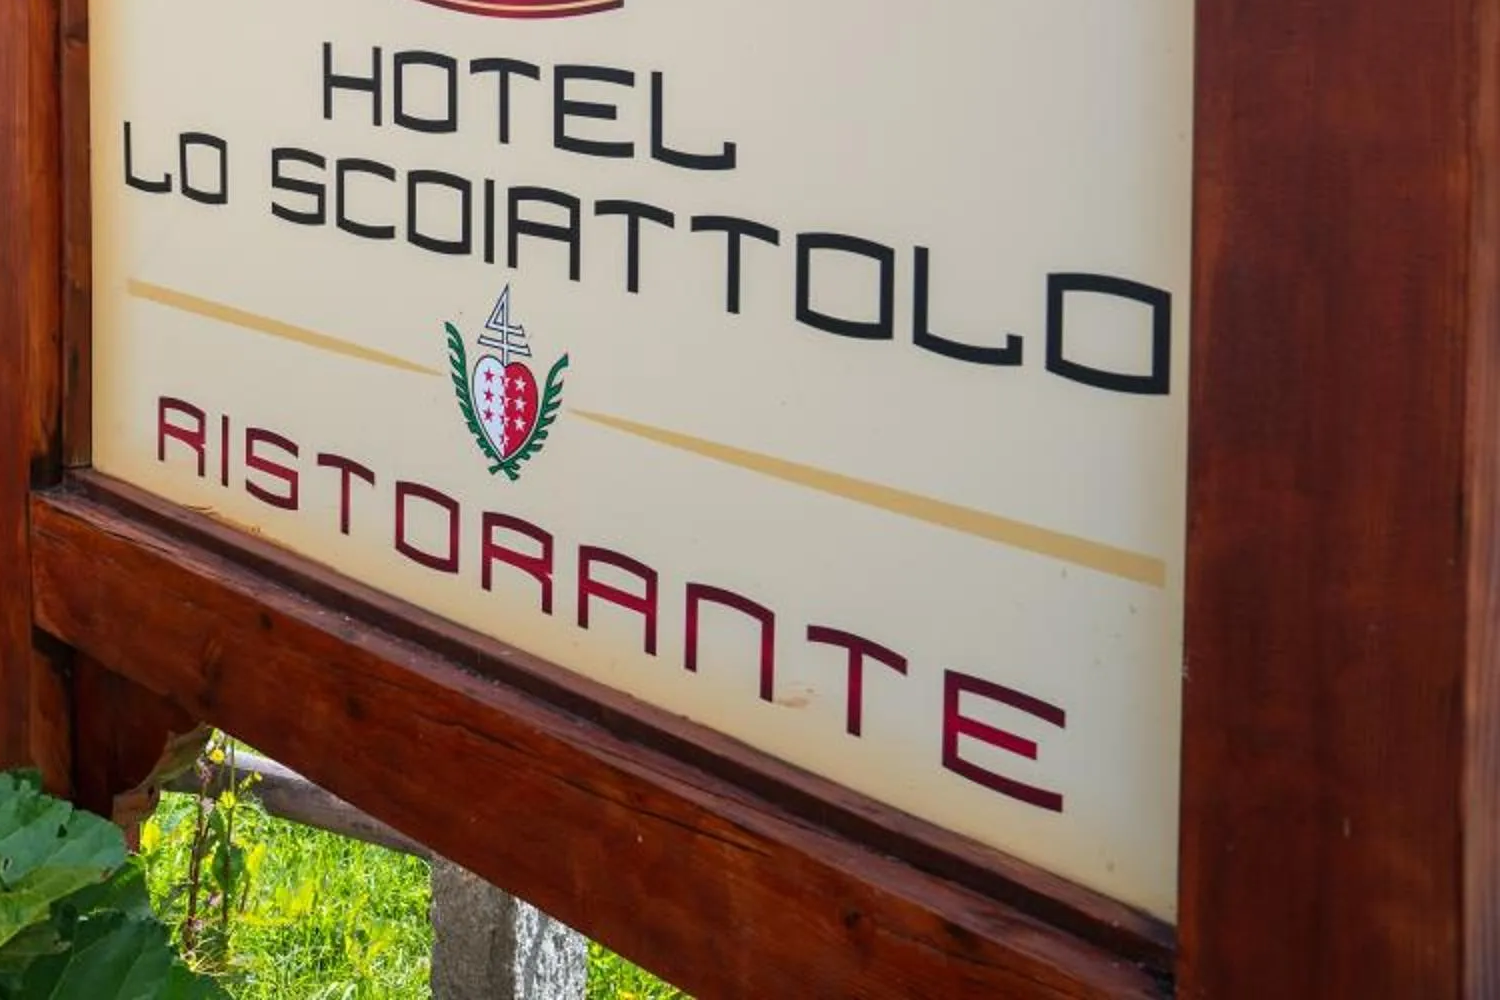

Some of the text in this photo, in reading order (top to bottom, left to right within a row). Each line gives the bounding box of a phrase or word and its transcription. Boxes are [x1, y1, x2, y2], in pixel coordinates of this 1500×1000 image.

[322, 42, 737, 171] HOTEL
[122, 121, 1173, 396] LO SCOIATTOLO
[157, 396, 1067, 813] RISTORANTE
